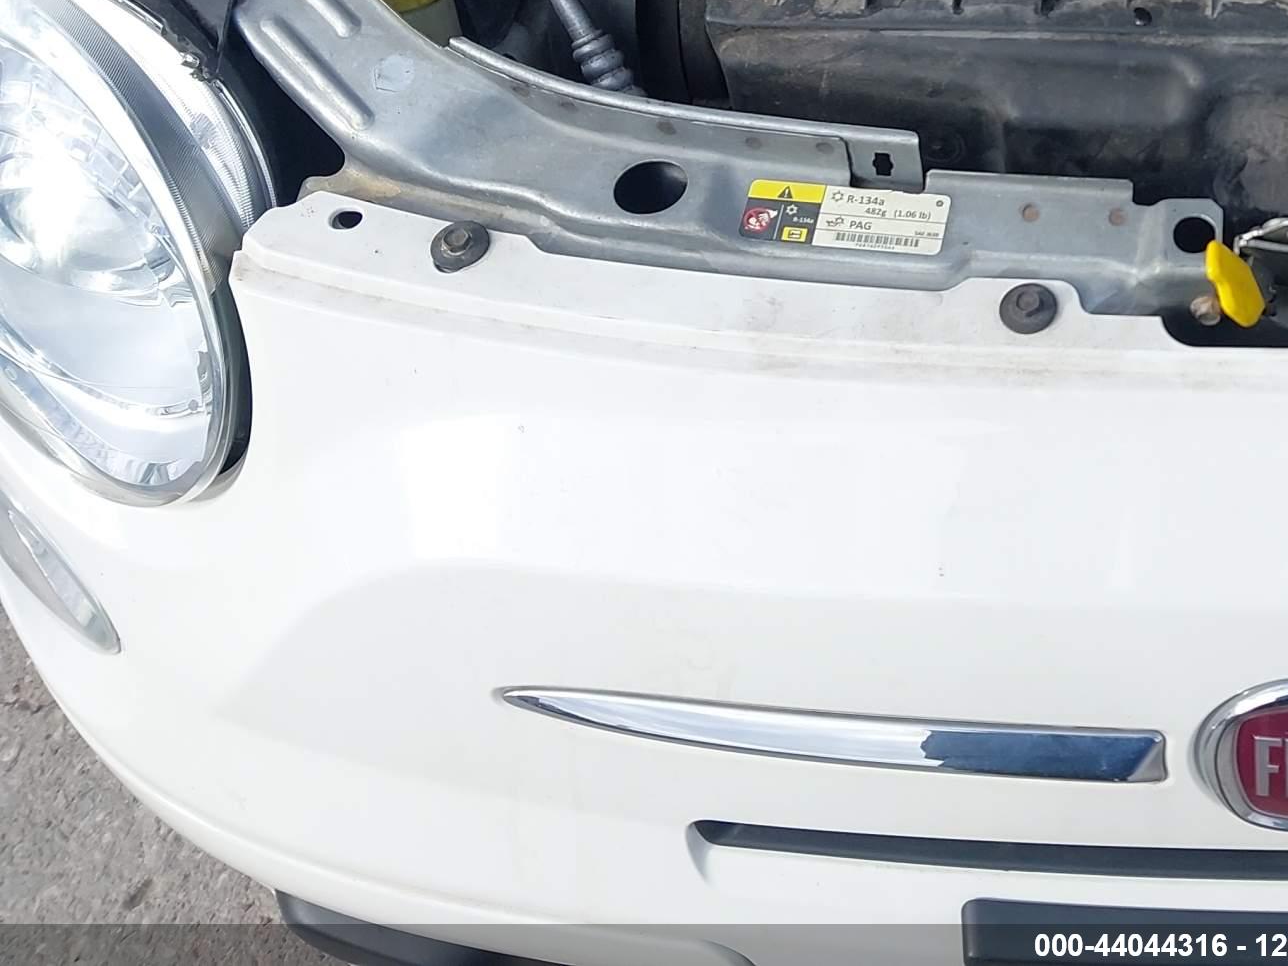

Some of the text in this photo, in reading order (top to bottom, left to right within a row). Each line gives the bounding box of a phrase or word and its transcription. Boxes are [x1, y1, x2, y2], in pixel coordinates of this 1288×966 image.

[846, 194, 885, 207] R-134a
[865, 207, 931, 220] 482g (1.06 lb)
[849, 220, 872, 231] PAG
